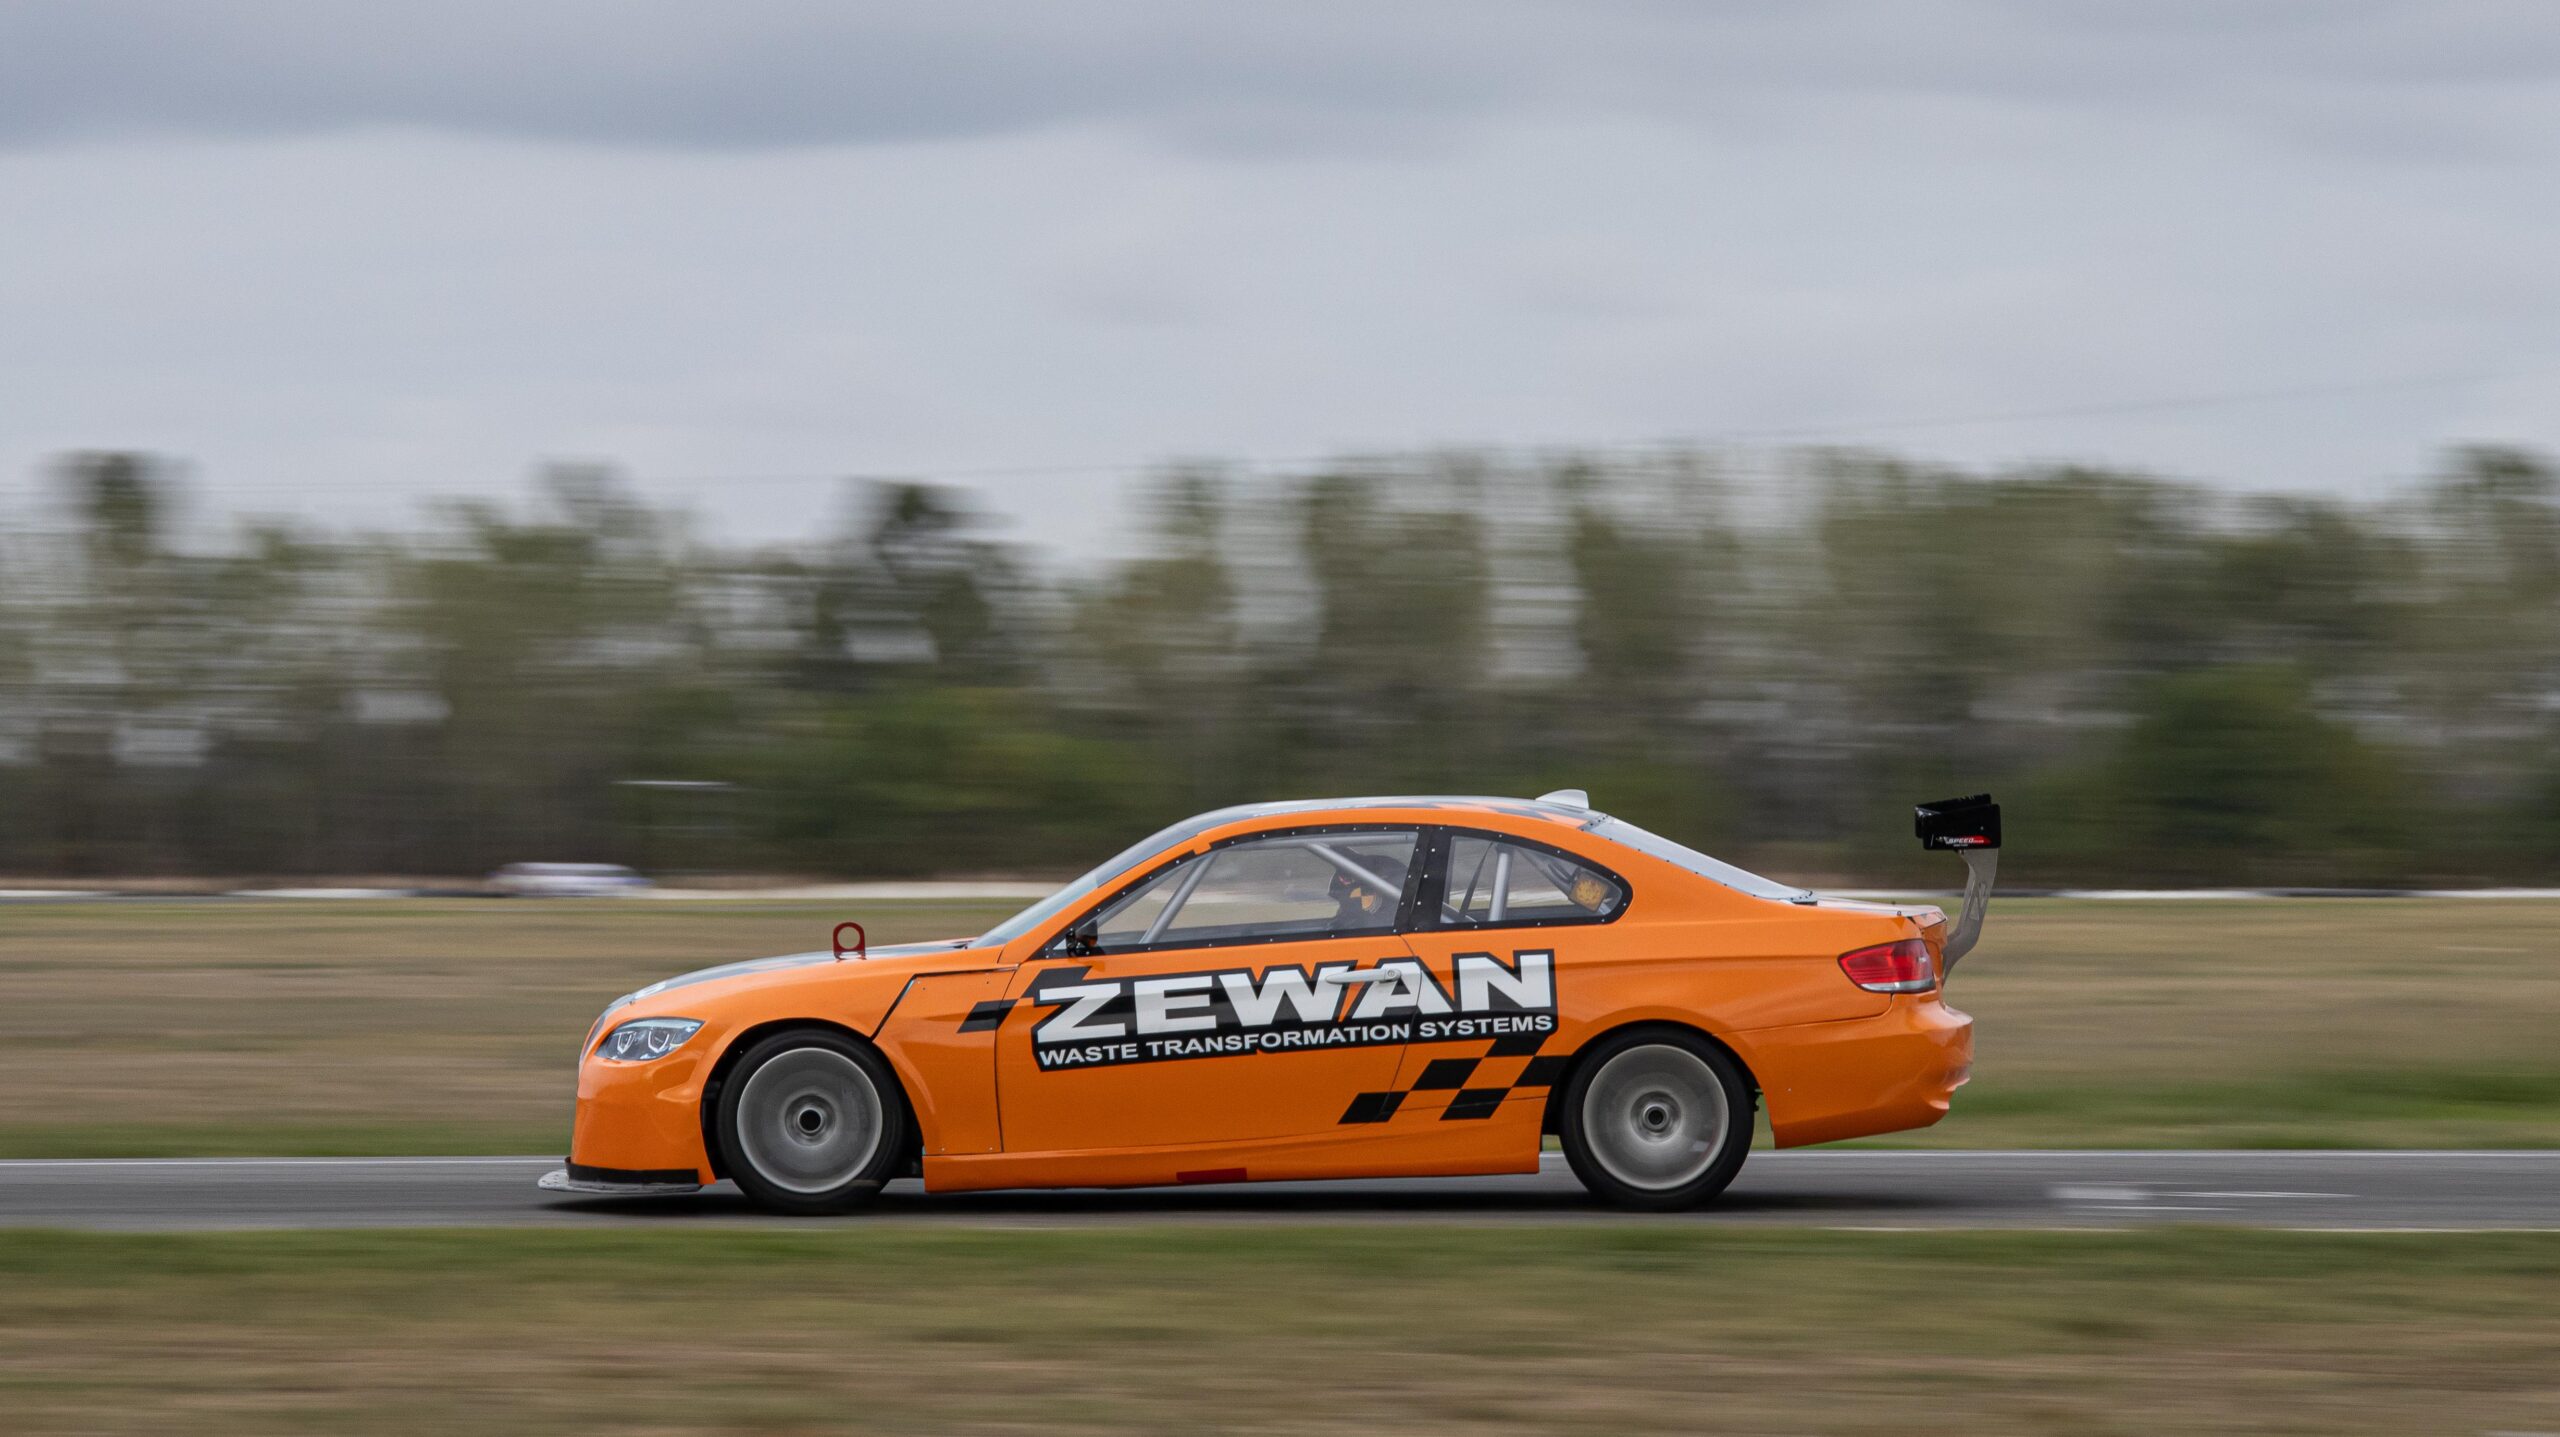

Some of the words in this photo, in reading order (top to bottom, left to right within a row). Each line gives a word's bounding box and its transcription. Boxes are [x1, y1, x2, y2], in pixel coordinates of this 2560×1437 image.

[1037, 954, 1552, 1043] ZEWAN
[1039, 1043, 1139, 1067] WASTE
[1145, 1023, 1411, 1056] TRANSFORMATION
[1419, 1015, 1553, 1038] SYSTEMS
